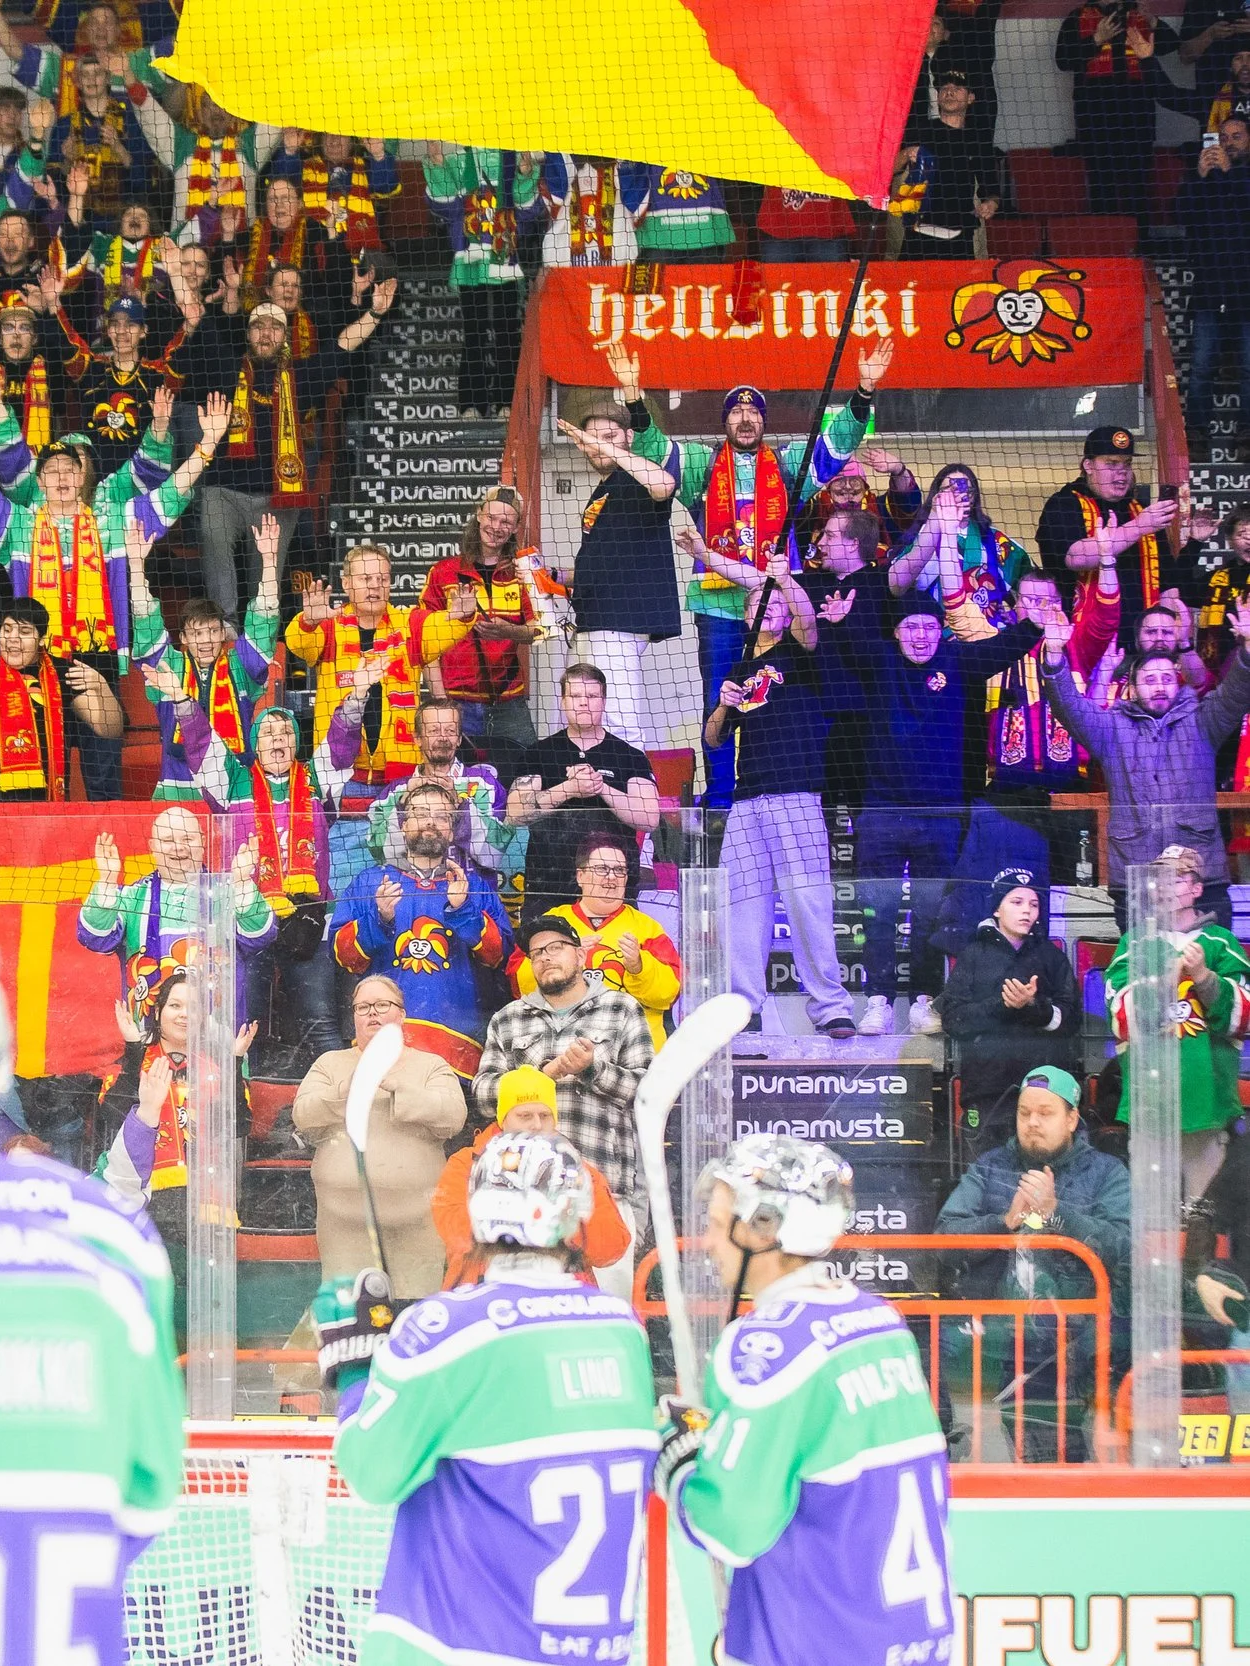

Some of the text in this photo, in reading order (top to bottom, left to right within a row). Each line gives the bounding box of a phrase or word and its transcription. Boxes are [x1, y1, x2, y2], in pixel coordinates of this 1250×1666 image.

[741, 1075, 908, 1100] punamusta
[736, 1112, 905, 1142] punamusta
[950, 1594, 1250, 1666] FUEL
